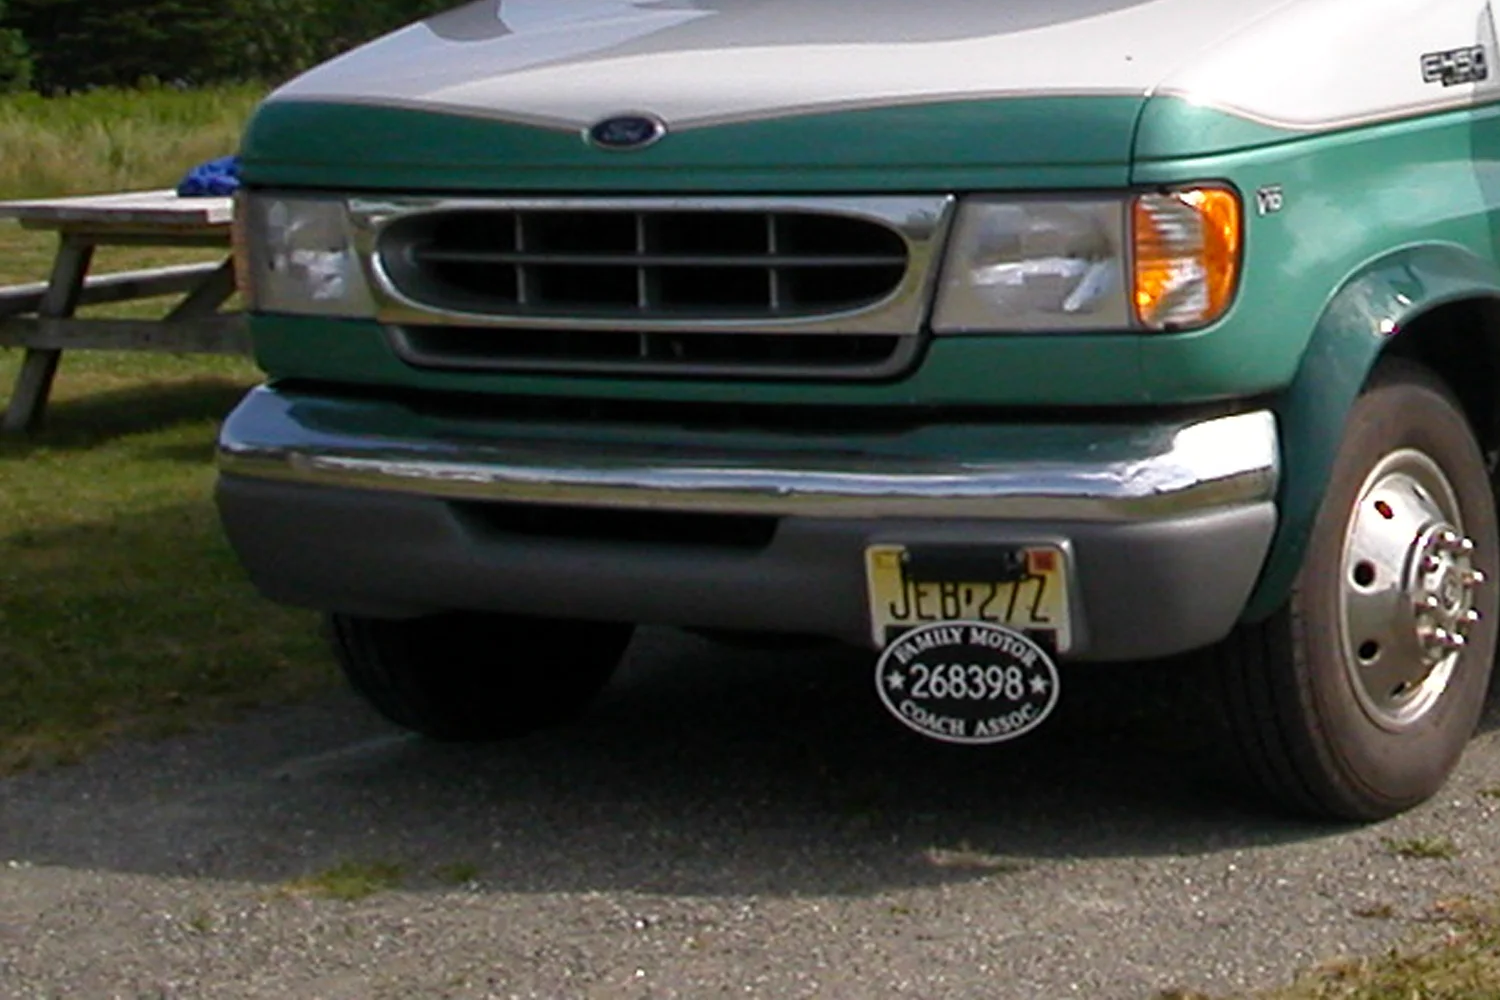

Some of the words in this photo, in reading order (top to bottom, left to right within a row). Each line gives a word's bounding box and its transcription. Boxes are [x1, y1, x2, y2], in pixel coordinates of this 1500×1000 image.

[893, 626, 965, 664] FAMILY
[969, 626, 1039, 668] MOTOR
[909, 662, 1025, 700] 268398
[901, 700, 966, 736] COACH
